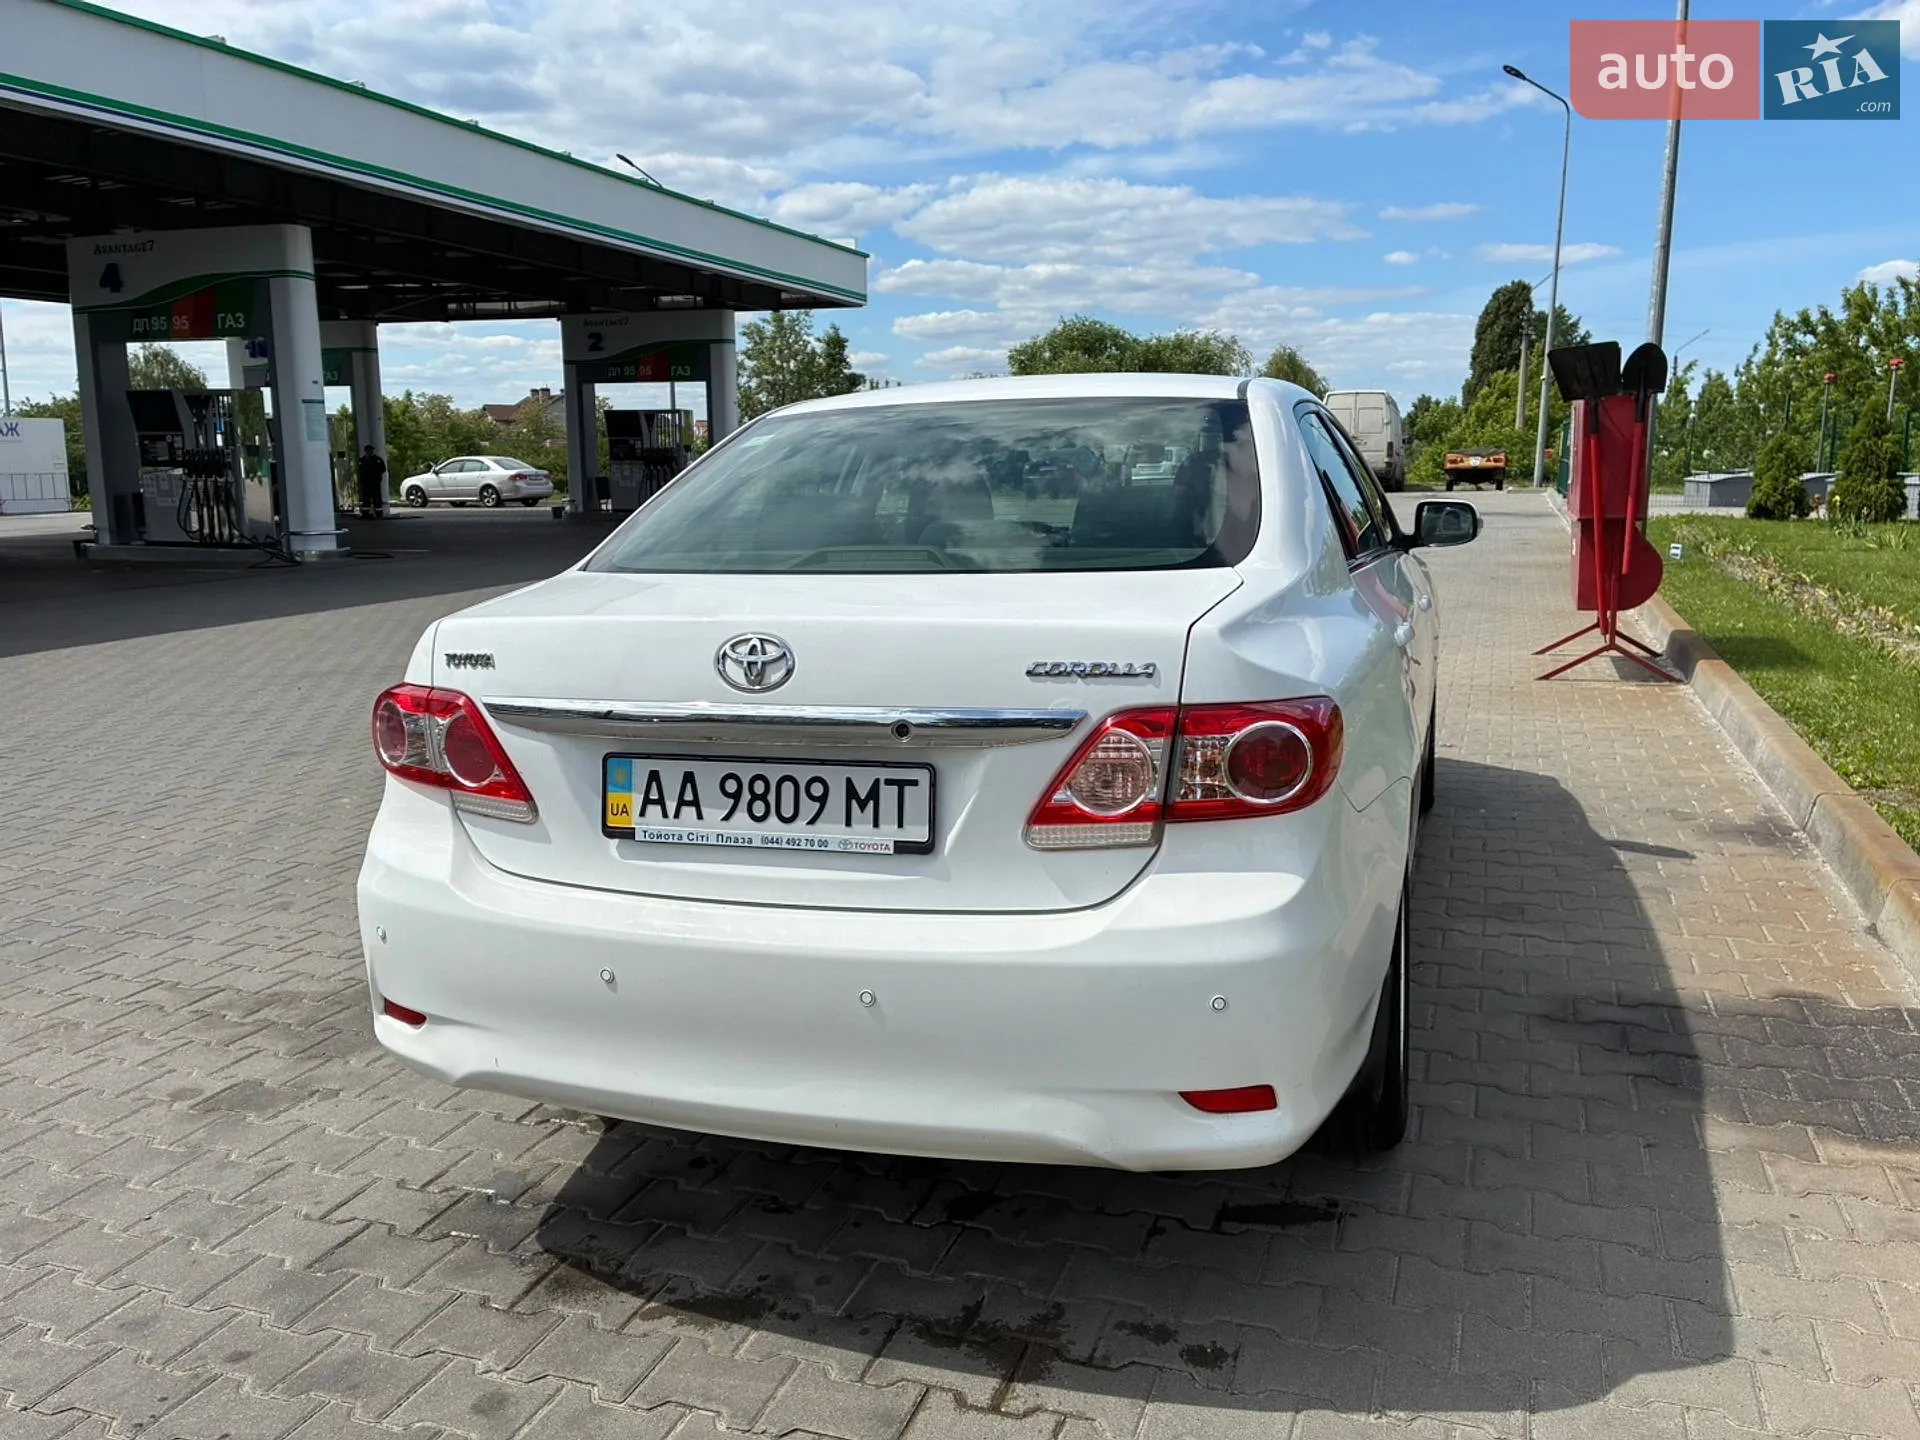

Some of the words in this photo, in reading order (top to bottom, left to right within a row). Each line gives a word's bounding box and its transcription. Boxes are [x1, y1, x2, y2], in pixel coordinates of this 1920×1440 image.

[99, 262, 123, 293] 4
[132, 317, 150, 334] ДП
[151, 316, 168, 331] 95
[172, 315, 190, 330] 95
[216, 313, 246, 329] ГАЗ
[588, 332, 604, 351] 2
[670, 365, 691, 376] ГАЗ
[444, 653, 496, 670] TOYOTA
[1025, 661, 1157, 679] COROLLA
[638, 769, 704, 821] AA
[718, 772, 830, 826] 9809
[844, 776, 920, 829] MT
[610, 803, 630, 817] UA
[642, 830, 683, 842] Тойота
[715, 833, 754, 845] Плаза
[760, 836, 784, 847] (044)
[785, 837, 803, 847] 492
[803, 838, 816, 848] 70
[816, 838, 829, 848] 00
[854, 842, 892, 852] TOYOTA
